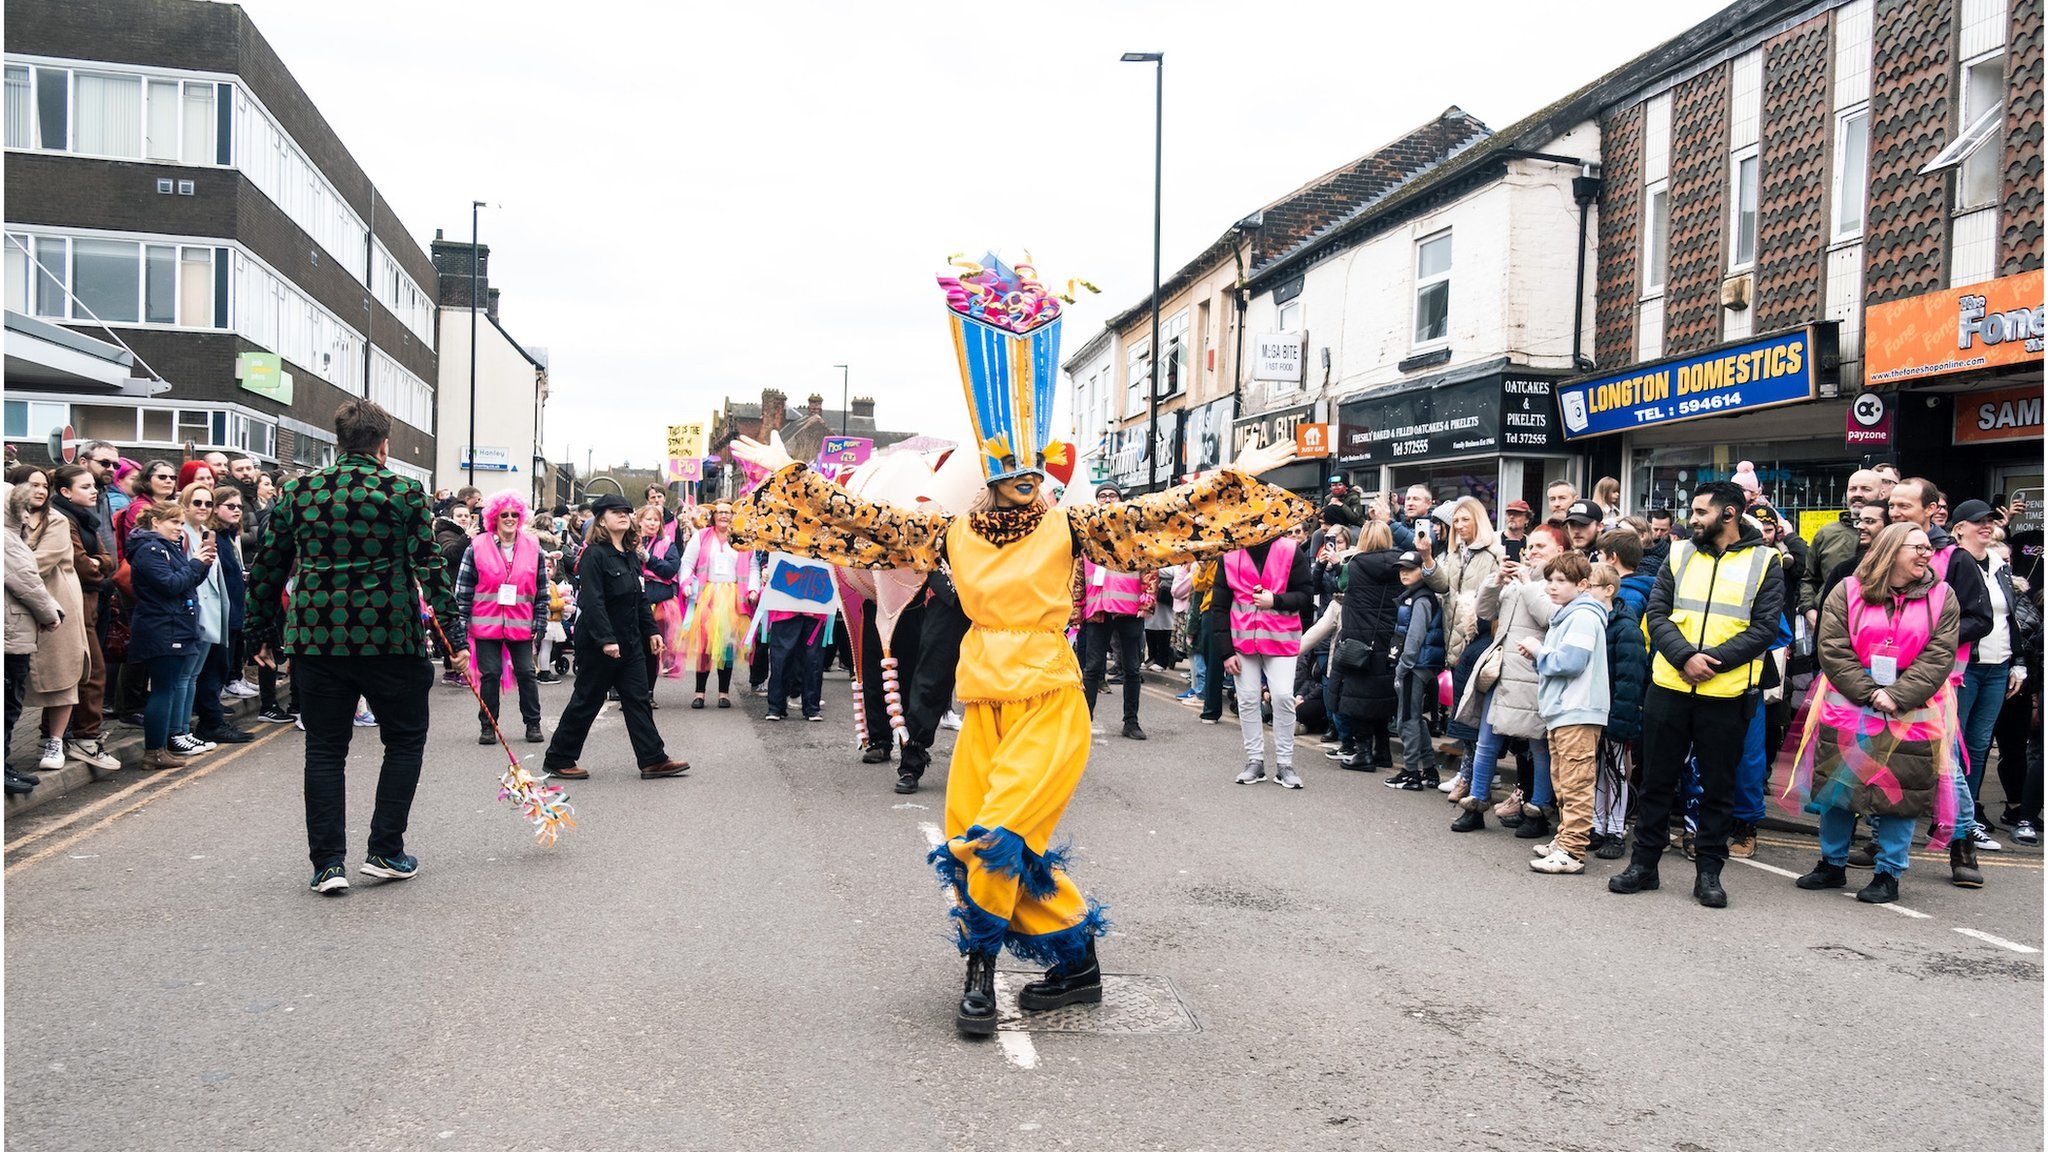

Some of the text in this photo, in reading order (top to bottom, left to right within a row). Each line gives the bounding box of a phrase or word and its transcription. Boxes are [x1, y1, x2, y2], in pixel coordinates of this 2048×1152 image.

[1958, 305, 2044, 350] Fone
[1283, 345, 1298, 360] BITE
[1280, 363, 1293, 372] FOOD
[1871, 356, 1985, 380] www.thefoneshoponline.com
[1588, 341, 1804, 414] LONGTON DOMESTICS
[1505, 380, 1550, 395] OATCAKES
[1523, 397, 1530, 410] &
[1634, 407, 1665, 422] TEL
[1679, 391, 1742, 415] 594614
[1507, 413, 1546, 427] PIKELETS
[1352, 430, 1373, 445] FRESHLY
[1373, 429, 1390, 442] BAKED
[1396, 426, 1414, 438] FILLED
[1414, 421, 1444, 436] OATCAKES
[1444, 420, 1450, 431] &
[1450, 416, 1479, 431] PIKELETS
[1848, 431, 1887, 442] payzone
[1505, 433, 1547, 445] Tel 372555
[480, 449, 505, 458] Hanley
[1314, 445, 1325, 453] EAT
[1392, 439, 1429, 457] Tel 372555
[2016, 523, 2034, 531] MON
